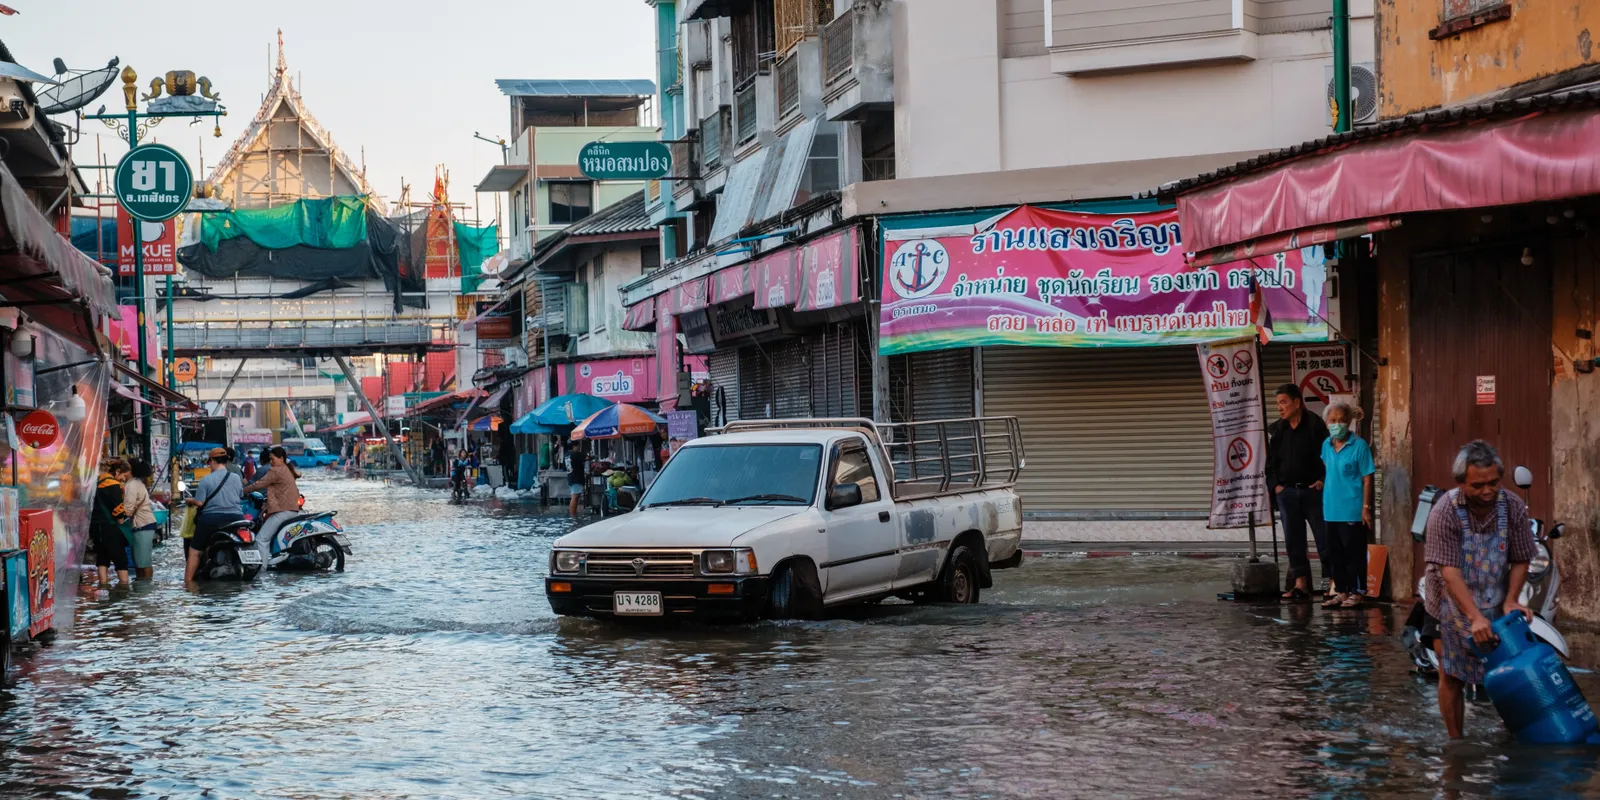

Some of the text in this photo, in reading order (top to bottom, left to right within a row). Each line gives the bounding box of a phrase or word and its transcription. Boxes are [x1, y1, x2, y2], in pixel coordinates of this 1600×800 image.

[582, 149, 668, 172] หมอสมปอง
[132, 160, 176, 191] ยา
[121, 244, 172, 258] MXUE
[953, 252, 1294, 303] จำหน่าย ชุดนักเรียน รองเท้า กระเป๋า
[989, 302, 1249, 332] สวย หล่อ เท่ แบรนด์เนมไทย
[1295, 350, 1307, 358] NO
[1296, 358, 1344, 370] 请勿吸烟
[1211, 379, 1230, 391] ห้าม
[22, 422, 55, 435] Coca-Cola
[617, 594, 658, 606] บจ 4288
